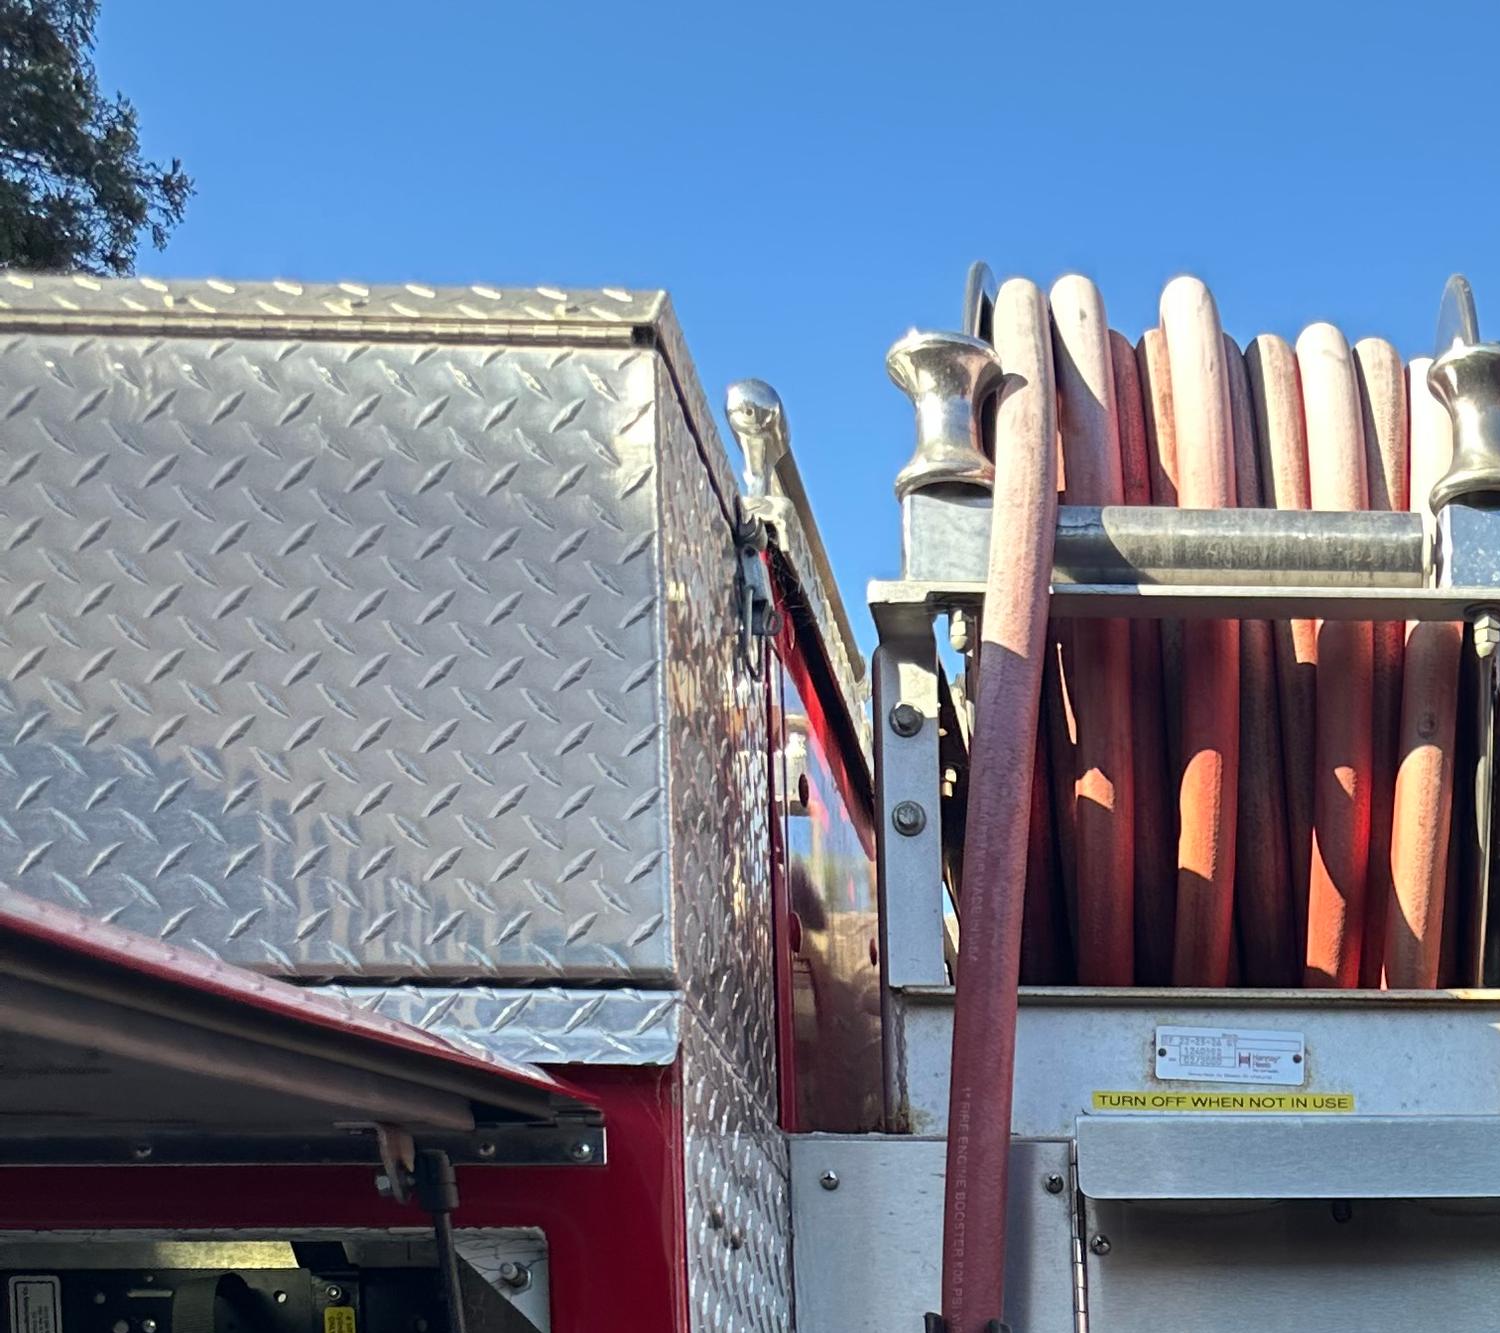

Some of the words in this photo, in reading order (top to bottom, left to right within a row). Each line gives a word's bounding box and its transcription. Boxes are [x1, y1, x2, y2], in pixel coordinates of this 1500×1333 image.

[959, 1102, 972, 1133] FIRE
[1098, 1095, 1146, 1107] TURN
[1150, 1096, 1187, 1107] OFF
[1191, 1096, 1244, 1108] WHEN
[1249, 1097, 1286, 1108] NOT
[1291, 1097, 1308, 1109] IN
[1313, 1098, 1349, 1109] USE
[956, 1136, 970, 1189] ENGINE
[952, 1191, 967, 1258] BOOSTER
